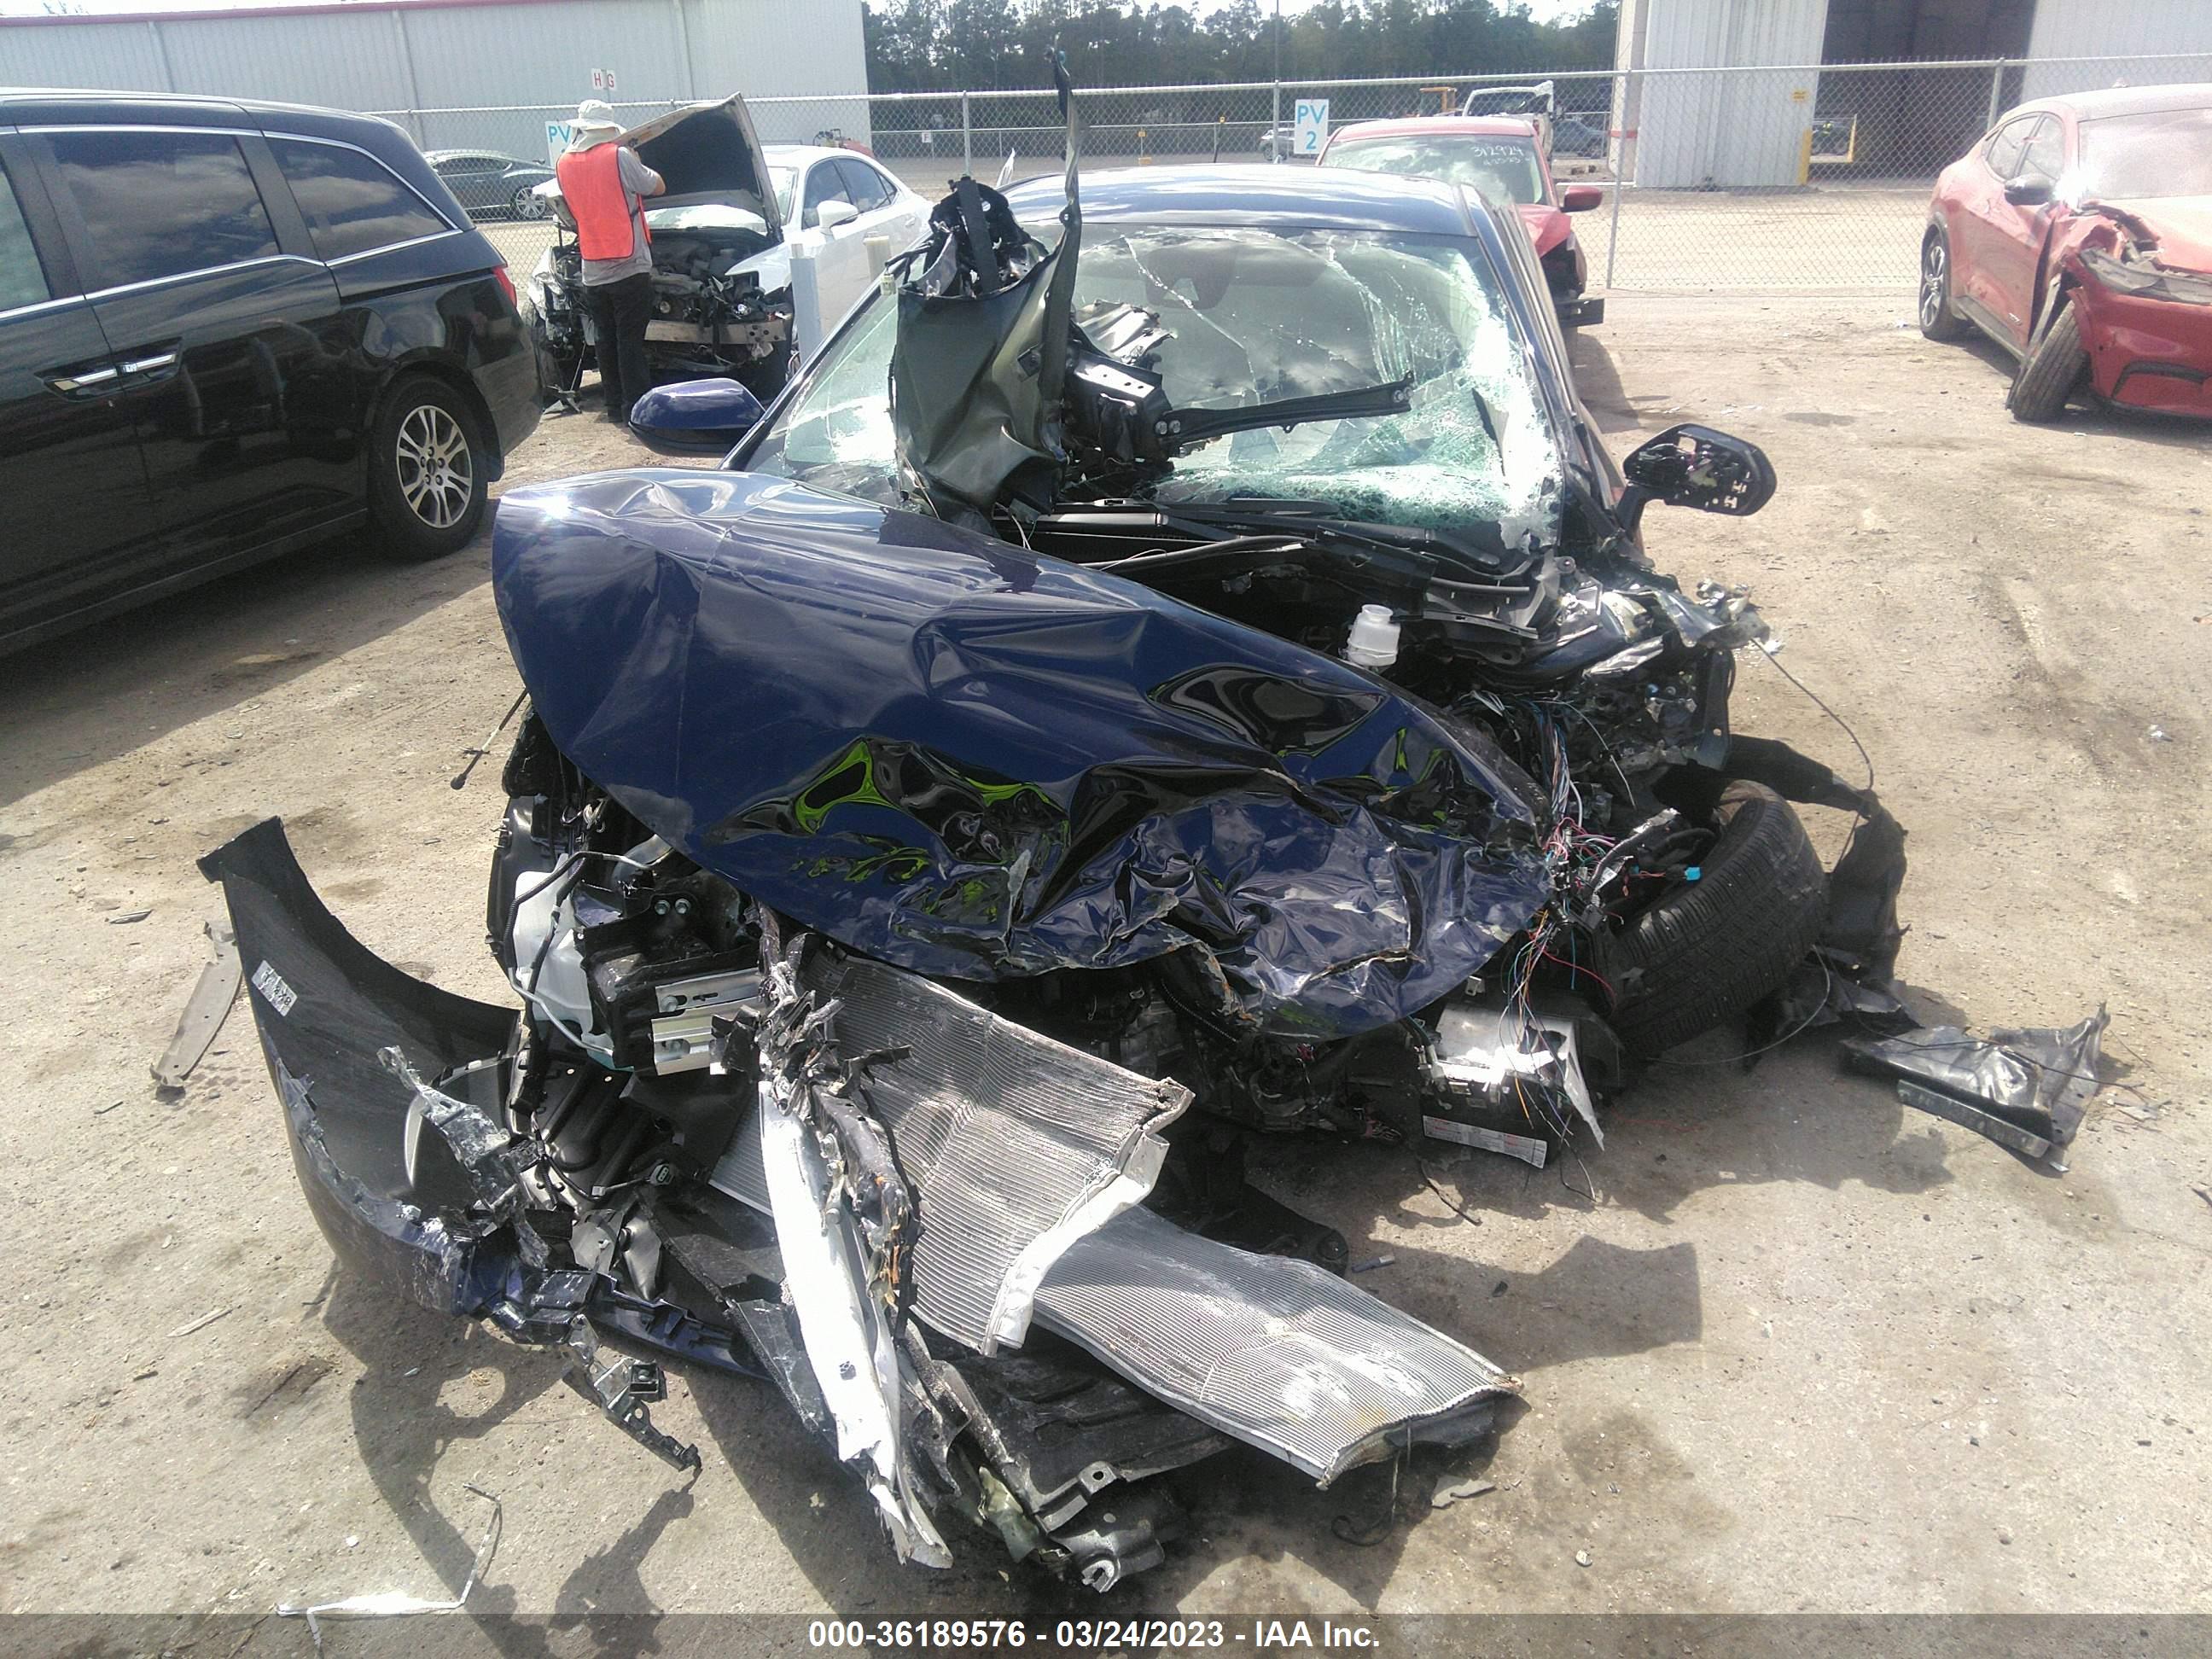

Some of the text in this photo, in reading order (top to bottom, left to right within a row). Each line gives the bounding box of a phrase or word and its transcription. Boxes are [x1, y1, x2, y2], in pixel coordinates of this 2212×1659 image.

[593, 73, 602, 87] H
[607, 73, 615, 88] G
[1297, 105, 1325, 125] PV
[548, 125, 571, 143] PV
[1306, 131, 1317, 150] 2
